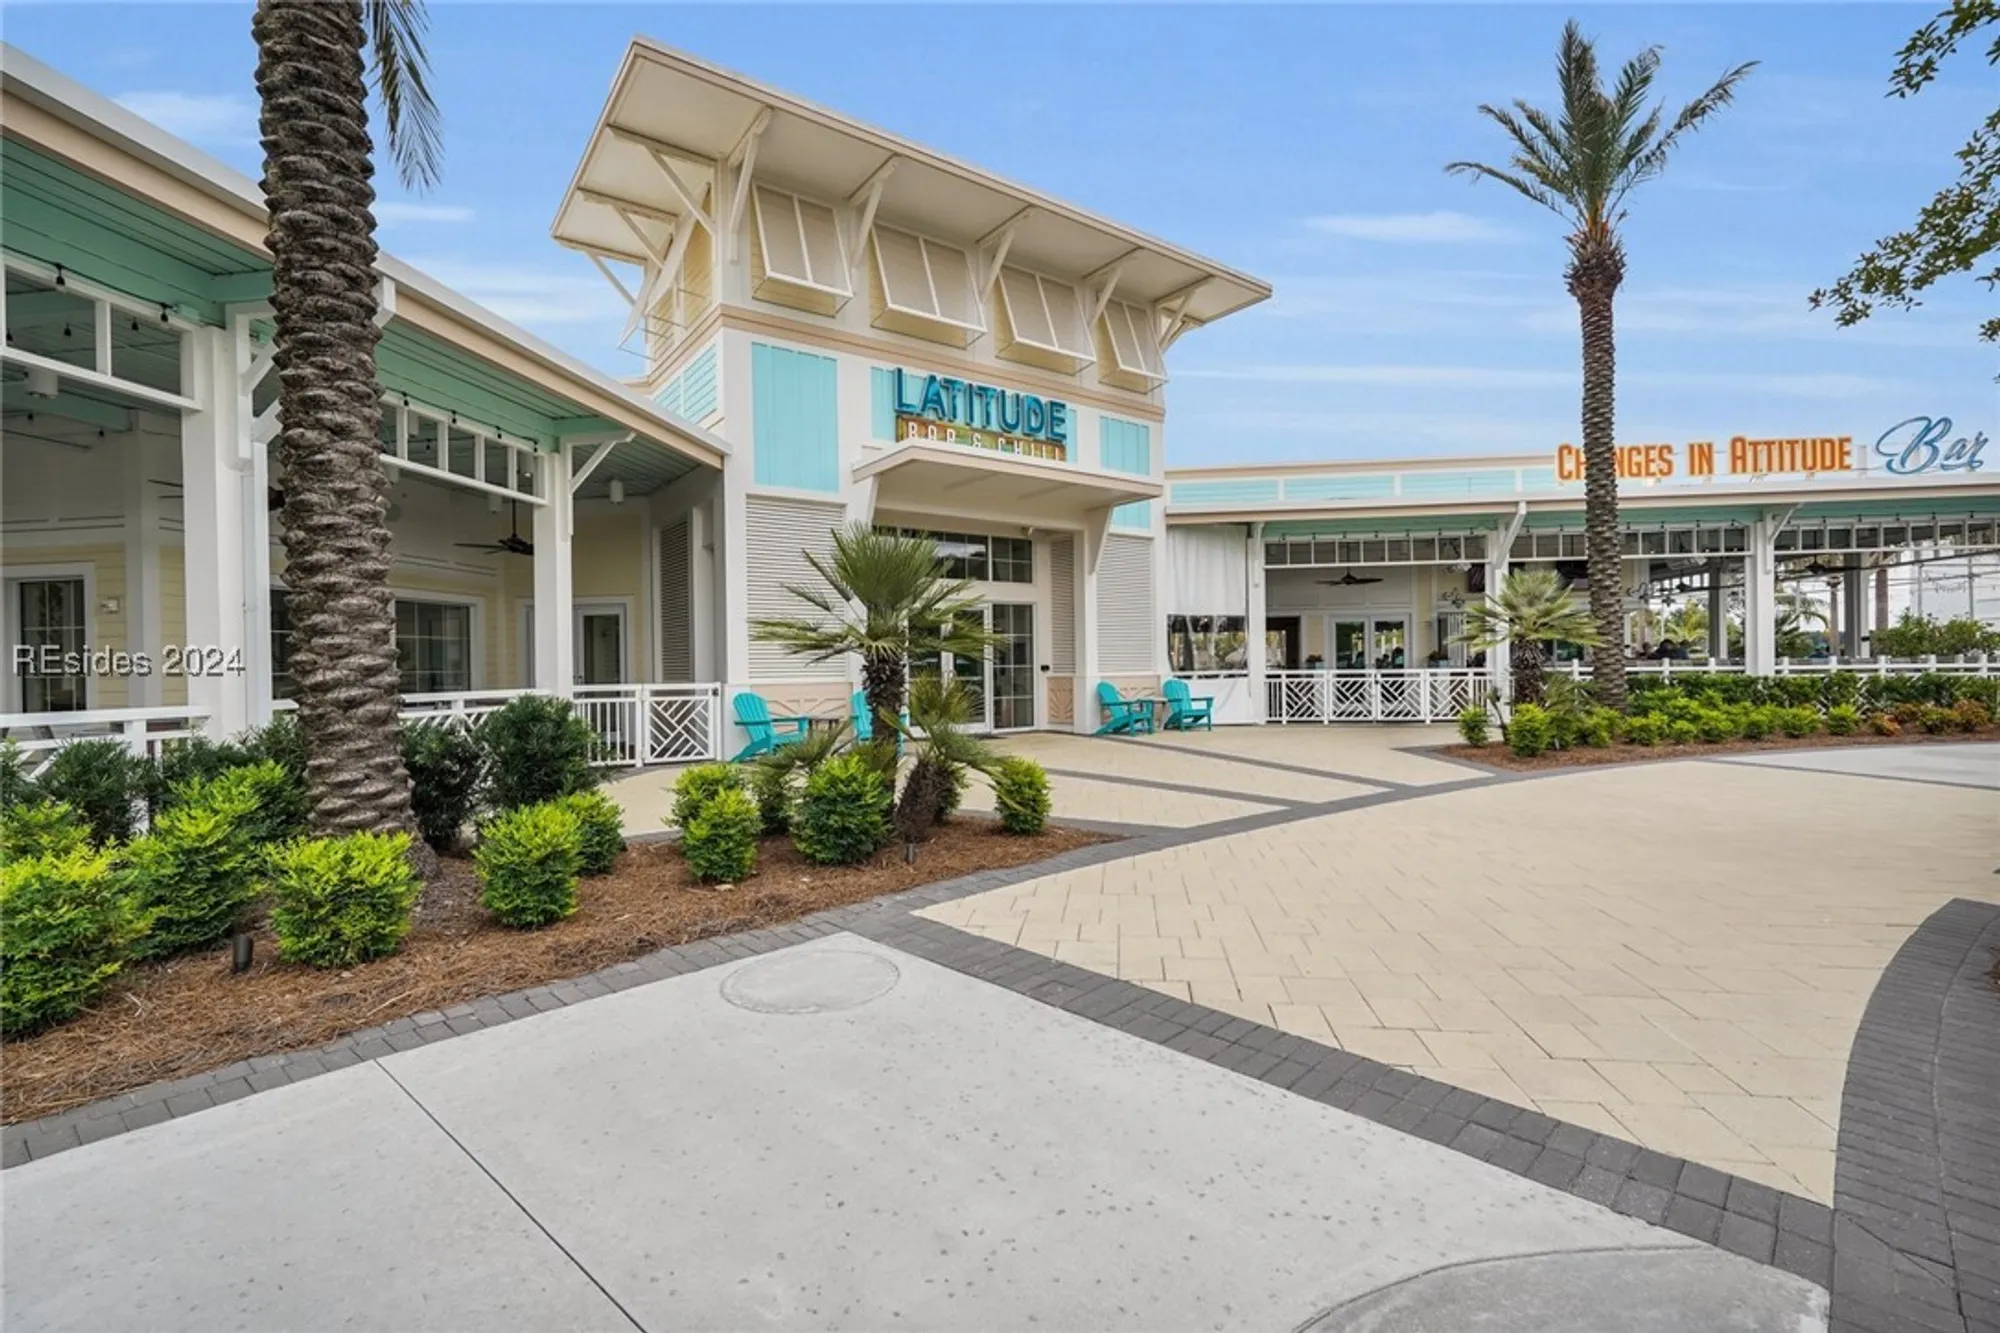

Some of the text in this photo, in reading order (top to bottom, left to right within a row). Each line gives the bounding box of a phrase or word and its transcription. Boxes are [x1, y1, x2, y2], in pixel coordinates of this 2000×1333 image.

[894, 367, 1067, 442] LATITUDE
[1556, 415, 1989, 481] CHNGES IN ATTITUDE Bar
